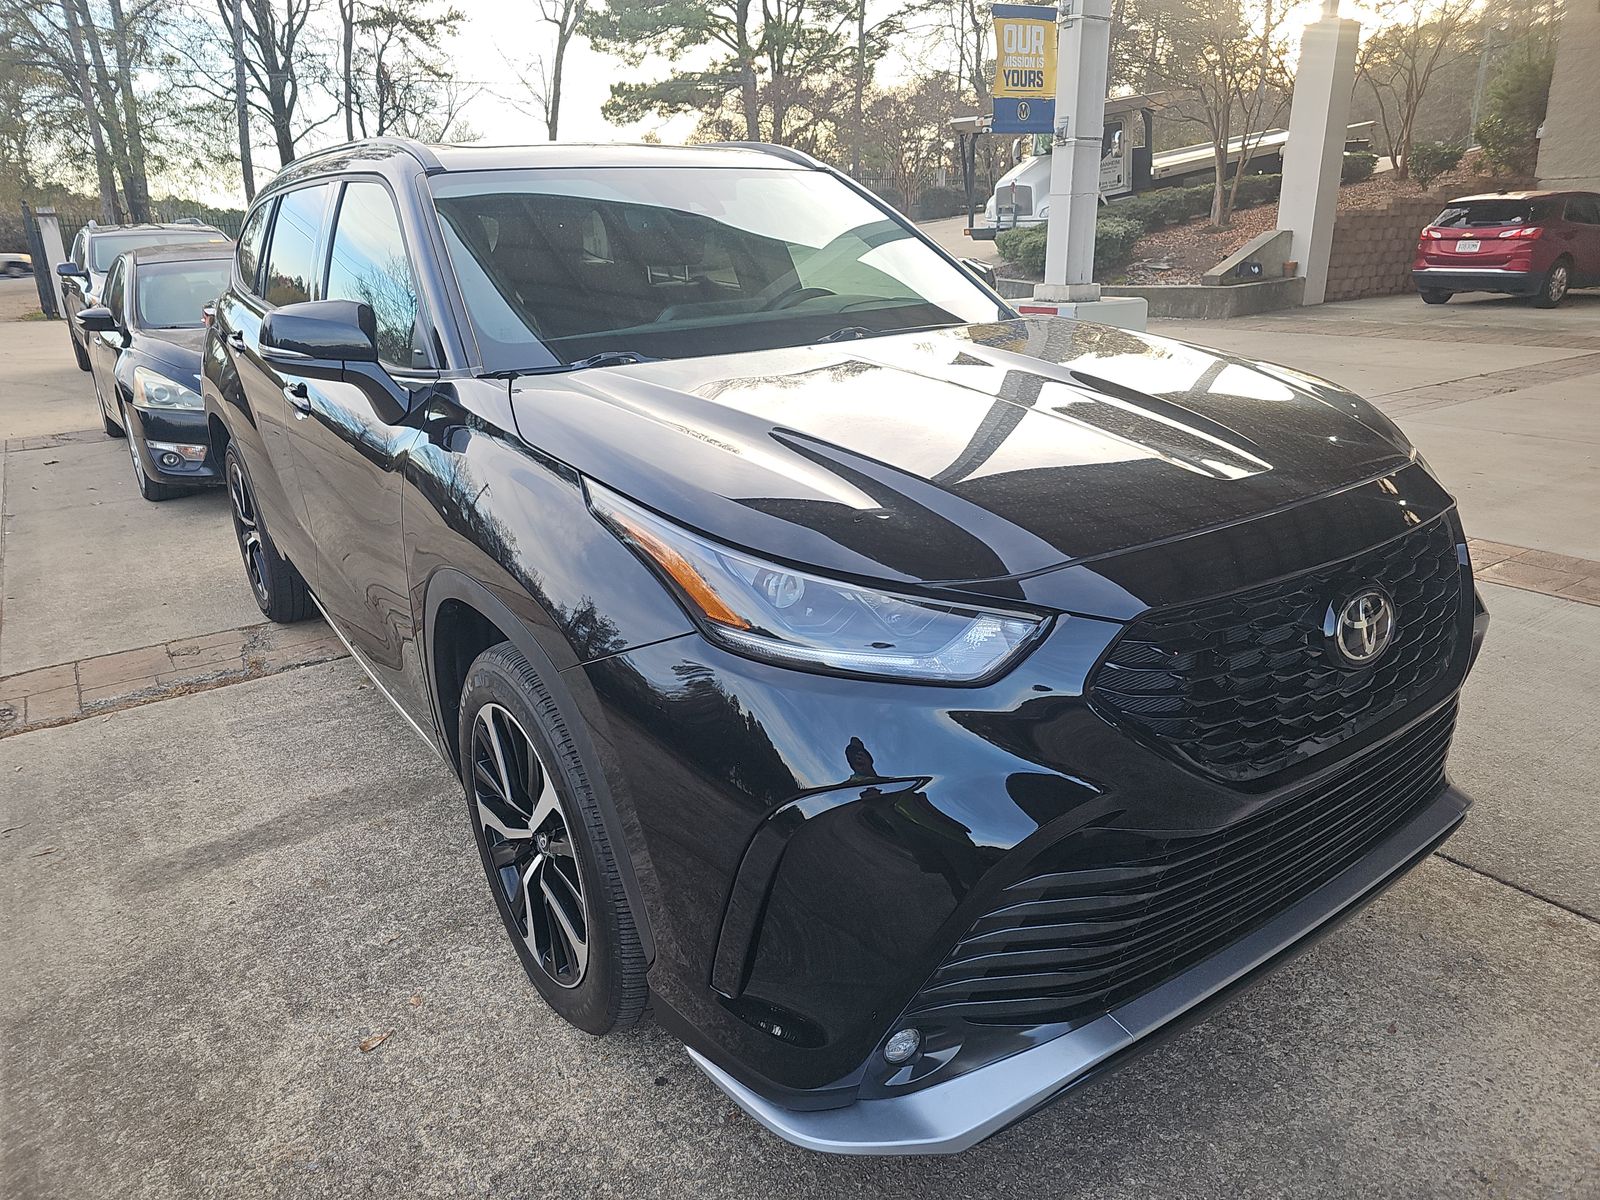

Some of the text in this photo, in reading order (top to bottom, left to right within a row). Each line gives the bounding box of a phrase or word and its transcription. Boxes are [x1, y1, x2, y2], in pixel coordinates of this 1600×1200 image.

[1003, 24, 1044, 54] OUR
[1003, 56, 1044, 68] MISSION IS
[1003, 69, 1044, 87] YOURS
